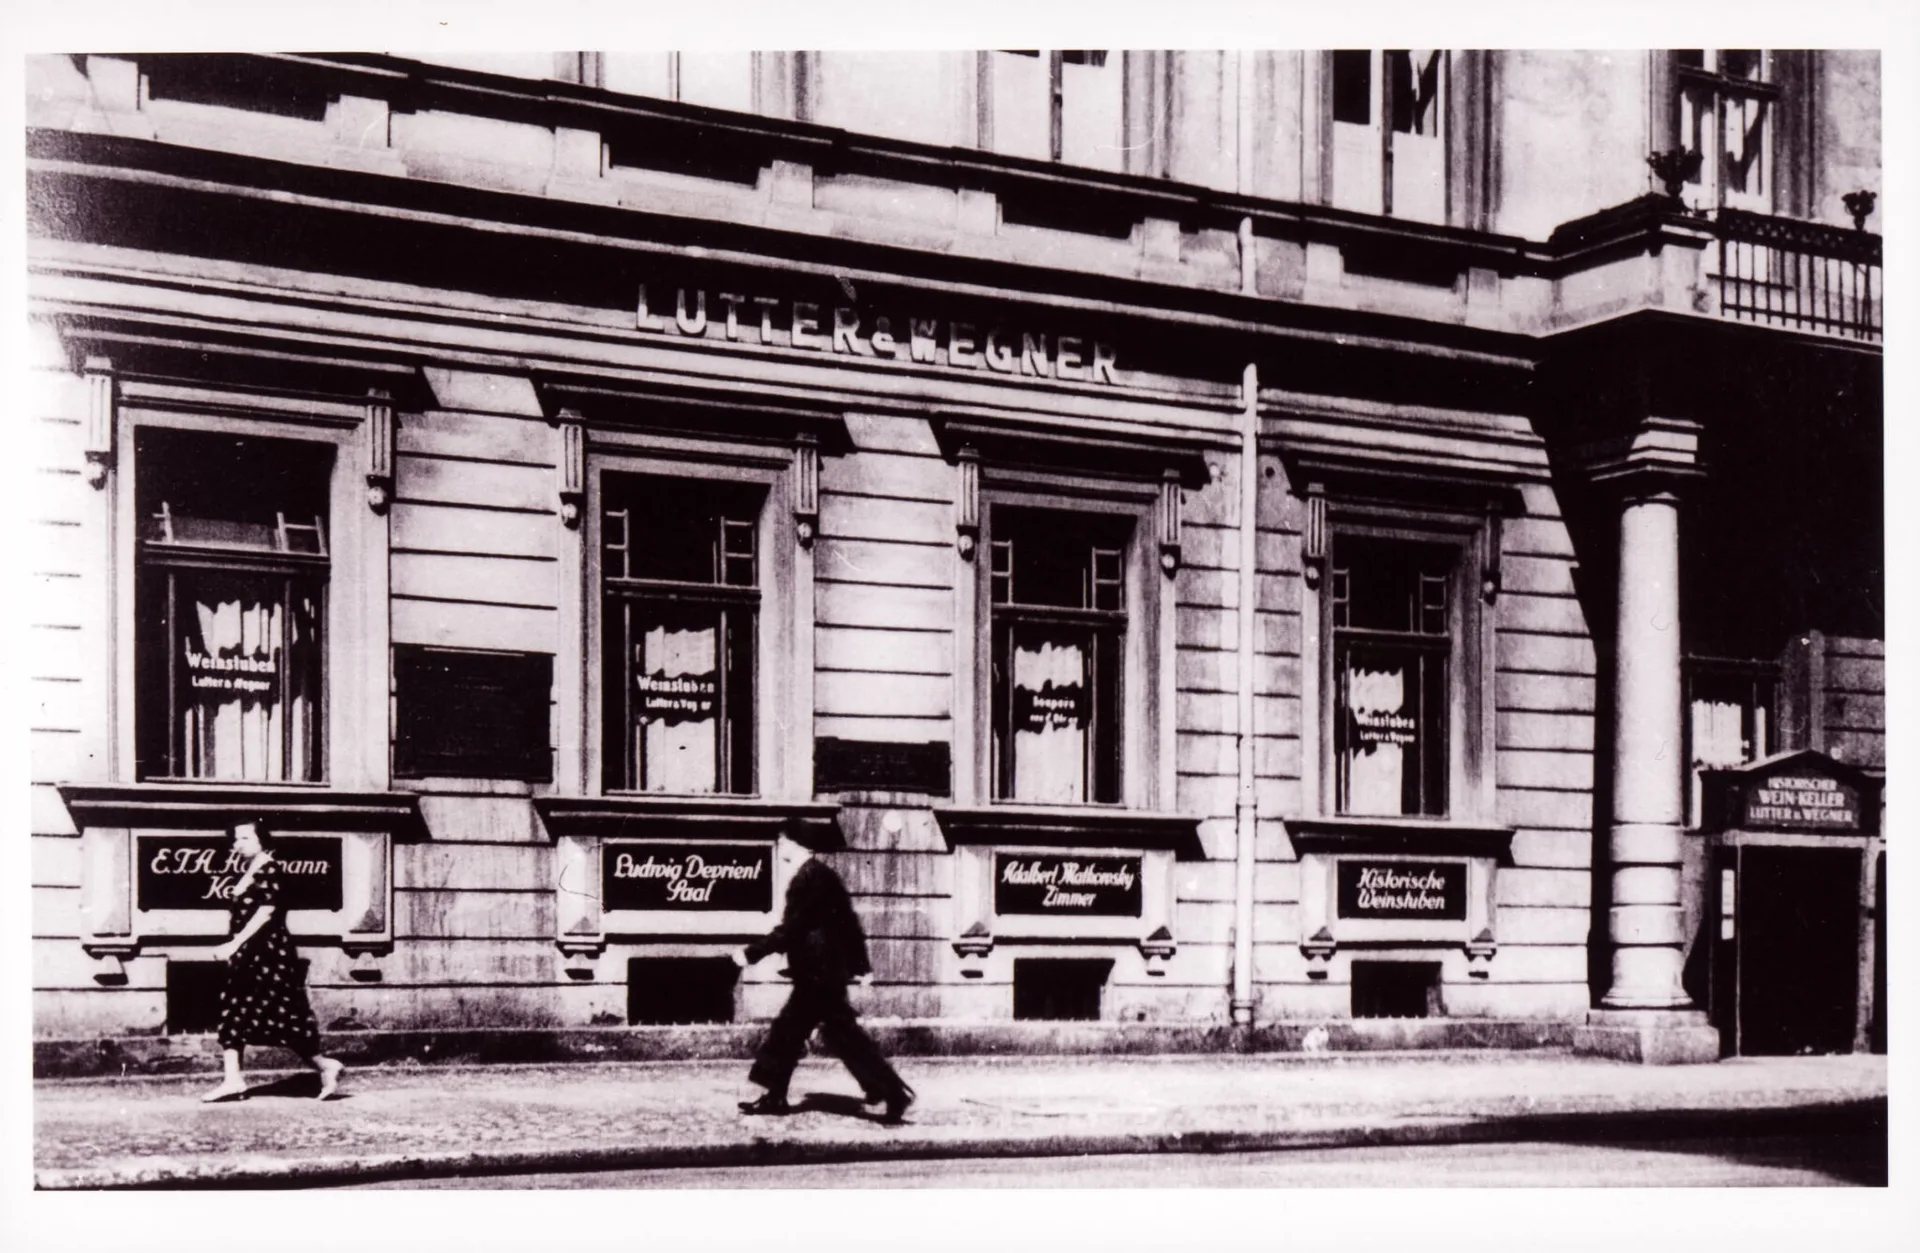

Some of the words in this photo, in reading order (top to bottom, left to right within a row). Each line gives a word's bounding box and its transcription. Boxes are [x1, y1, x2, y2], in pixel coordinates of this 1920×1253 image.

[637, 284, 862, 353] LUTTER
[871, 316, 897, 353] &
[910, 317, 1119, 385] WEGNER
[185, 652, 275, 673] Weinstuben
[637, 675, 714, 693] Weinstuben
[1749, 805, 1792, 820] LUTTER
[1802, 807, 1853, 823] WEGNER
[614, 853, 682, 880] Ludwig
[1001, 860, 1059, 884] Adalbert
[1356, 867, 1445, 890] Historische
[666, 879, 716, 902] Saal
[1042, 884, 1097, 907] Zimmer
[1357, 888, 1445, 909] Weinstuben
